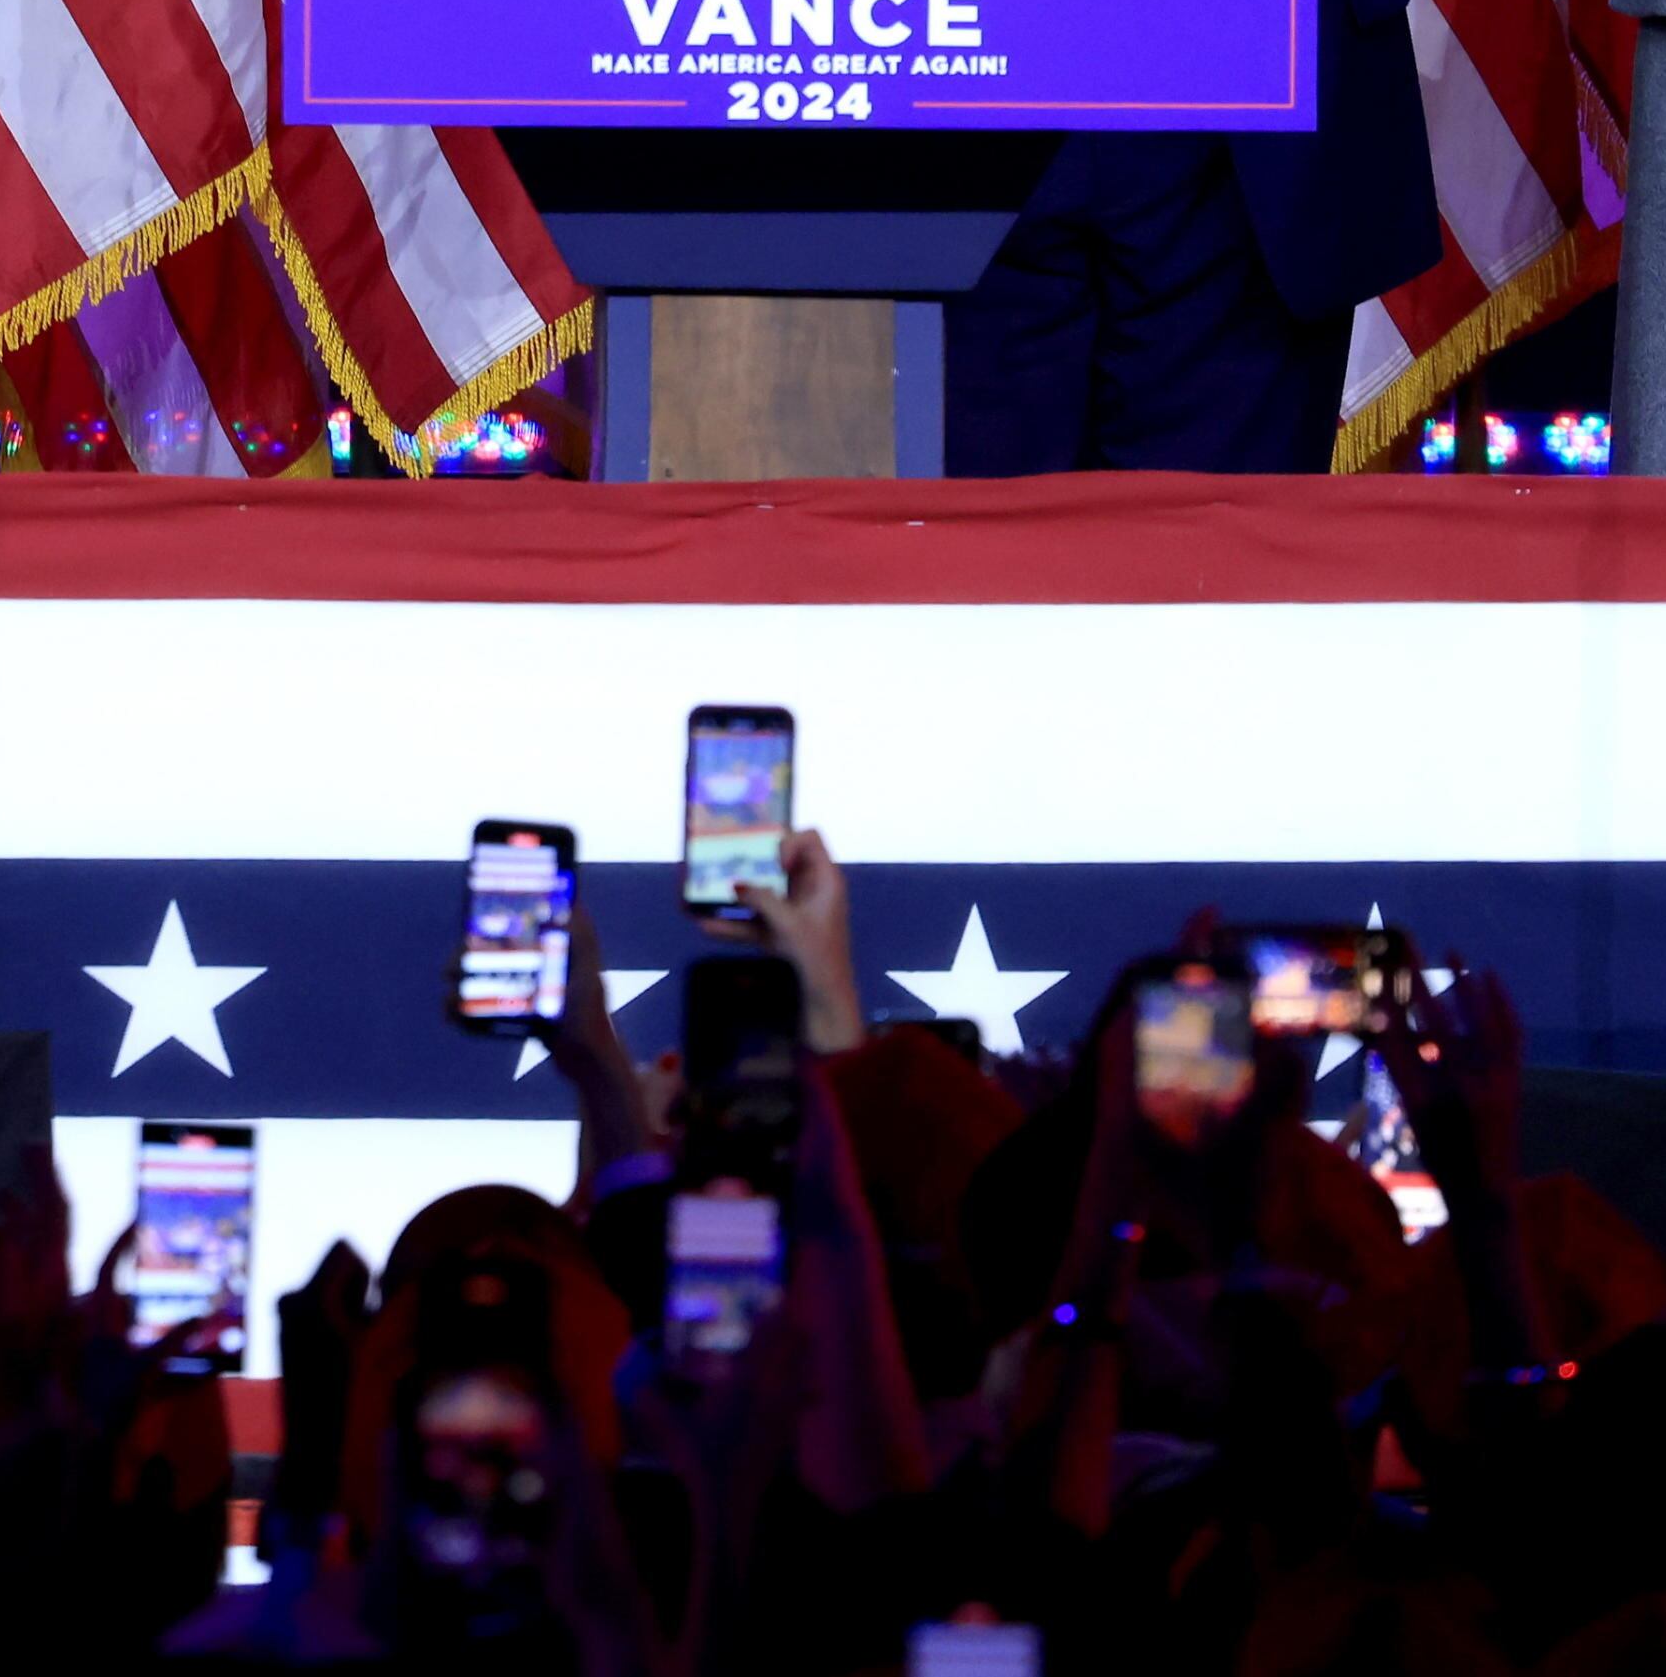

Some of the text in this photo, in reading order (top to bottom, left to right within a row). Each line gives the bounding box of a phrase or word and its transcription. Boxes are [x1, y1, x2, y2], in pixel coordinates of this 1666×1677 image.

[591, 53, 1008, 76] MAKE AMERICA GREAT AGAIN!
[727, 81, 872, 121] 2024
